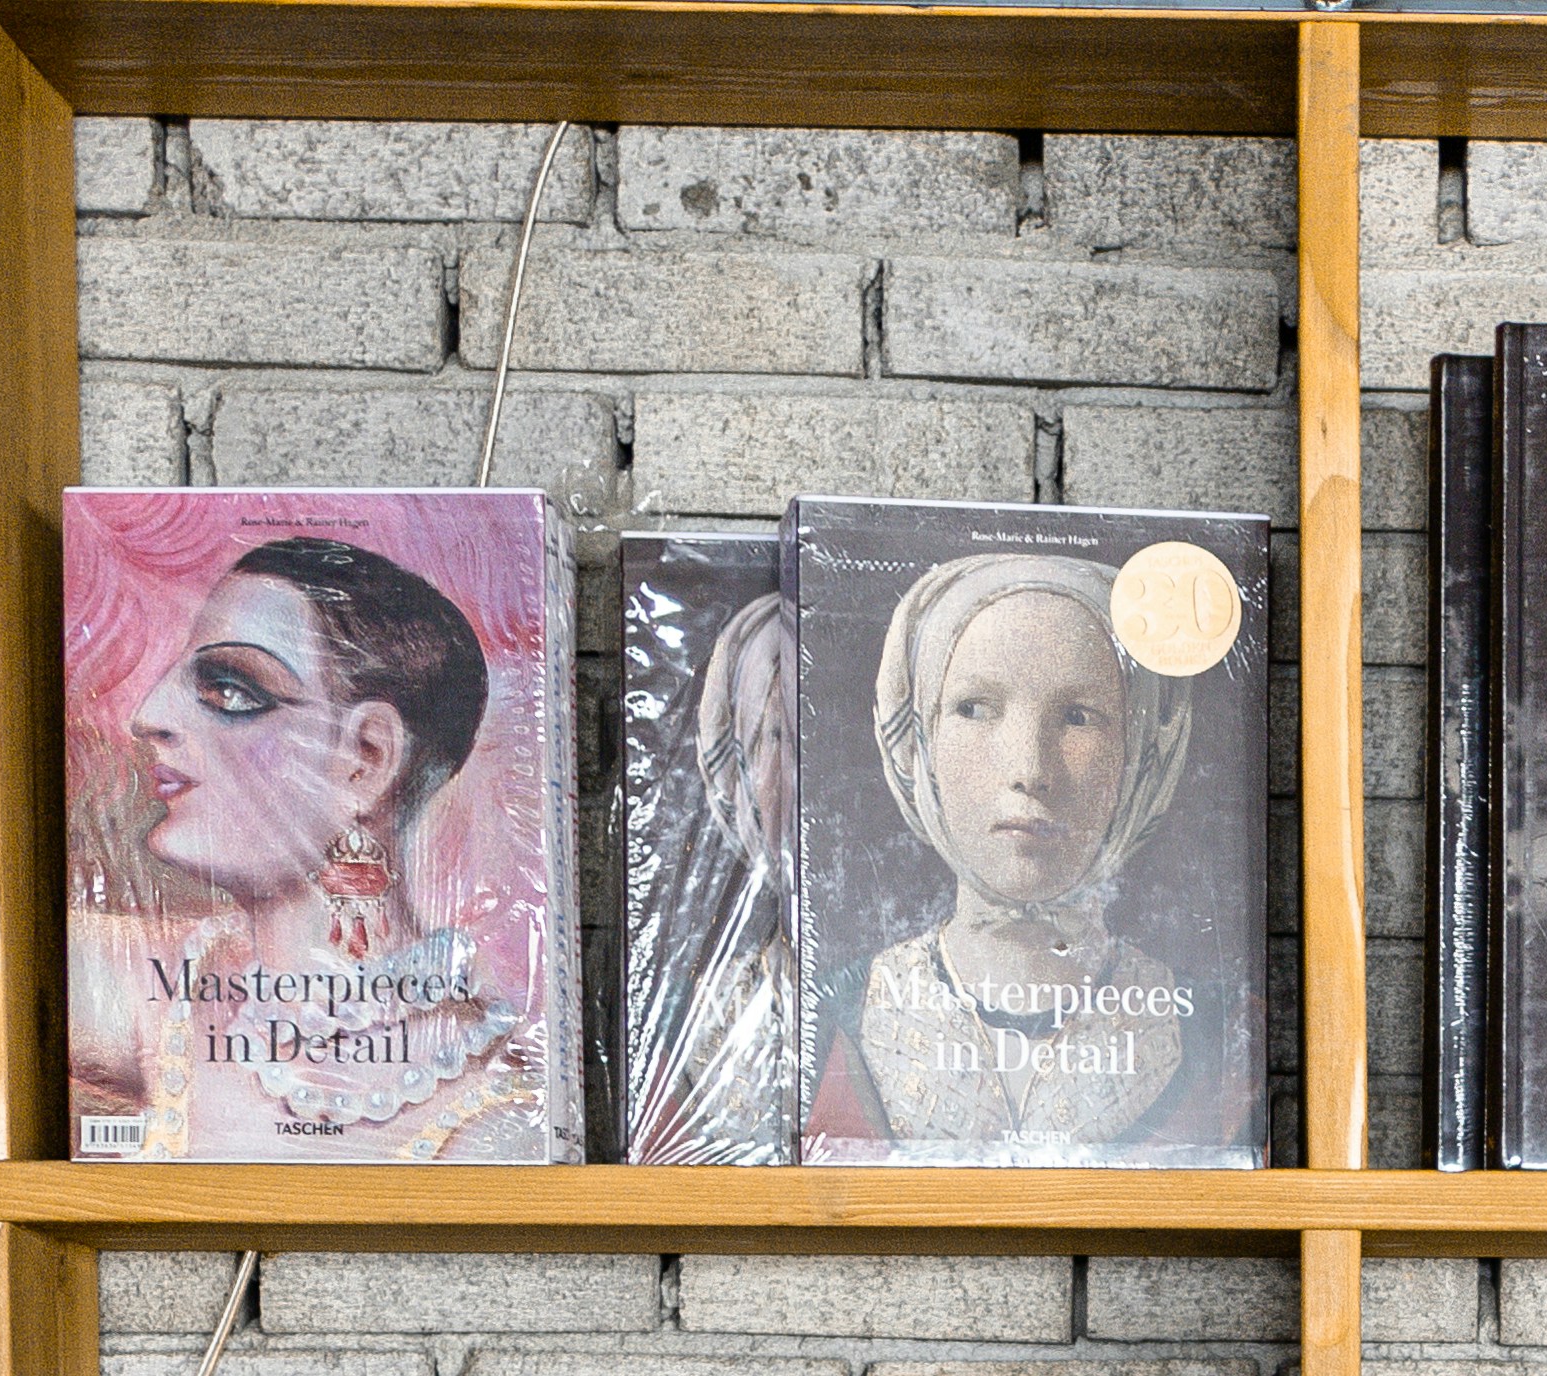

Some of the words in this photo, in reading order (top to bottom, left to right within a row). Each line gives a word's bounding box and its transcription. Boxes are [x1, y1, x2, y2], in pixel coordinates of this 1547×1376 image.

[972, 530, 1022, 543] Rose-Marie
[1025, 533, 1033, 543] &
[1036, 534, 1066, 544] Rainer
[1069, 536, 1099, 548] Hagen
[148, 958, 470, 1018] Masterpieces
[876, 965, 1195, 1029] Masterpieces
[205, 1024, 254, 1063] in
[265, 1019, 411, 1063] Detail
[935, 1031, 982, 1072] in
[995, 1027, 1138, 1076] Detail
[274, 1122, 343, 1137] TASCHEN
[1003, 1129, 1070, 1142] TASCHEN
